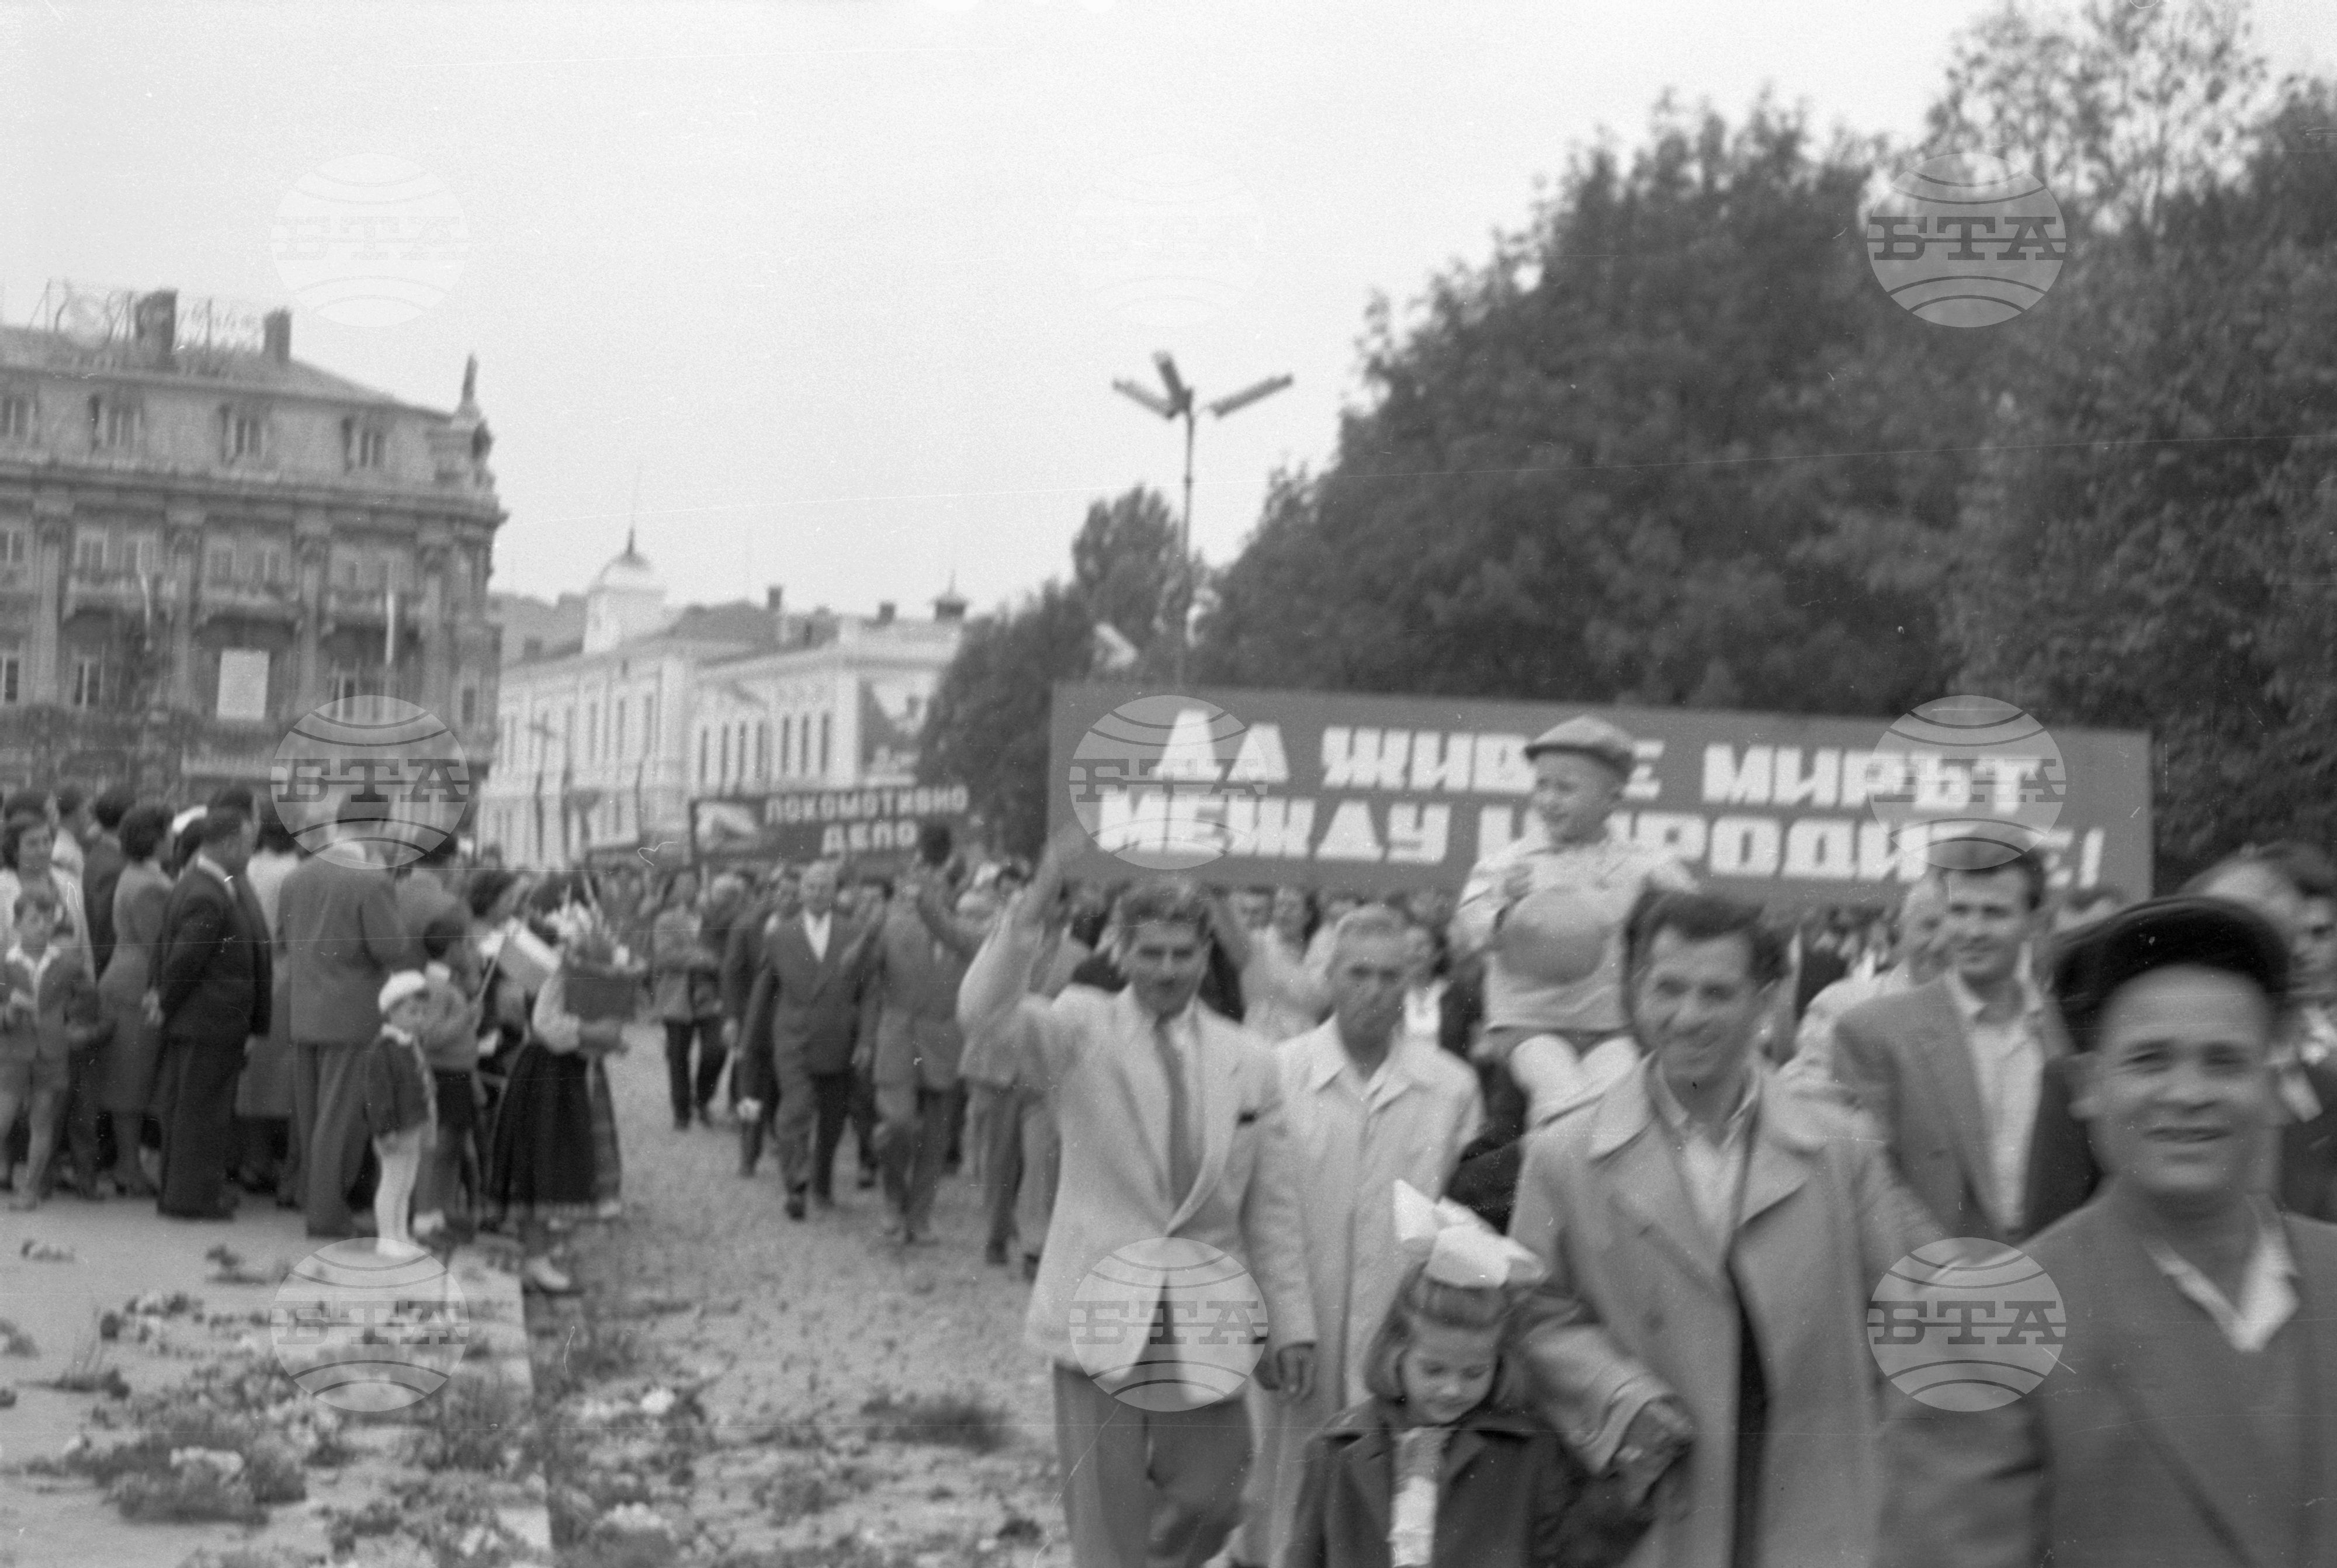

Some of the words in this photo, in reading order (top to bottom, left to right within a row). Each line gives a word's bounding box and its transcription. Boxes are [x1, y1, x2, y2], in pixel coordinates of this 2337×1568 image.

[1153, 709, 1287, 783] ДА
[1320, 726, 1665, 800] ЖИВЕ
[1701, 741, 2043, 816] МИРЪТ
[821, 819, 918, 855] ДЕПО
[1098, 787, 1452, 865] МЕЖДУ
